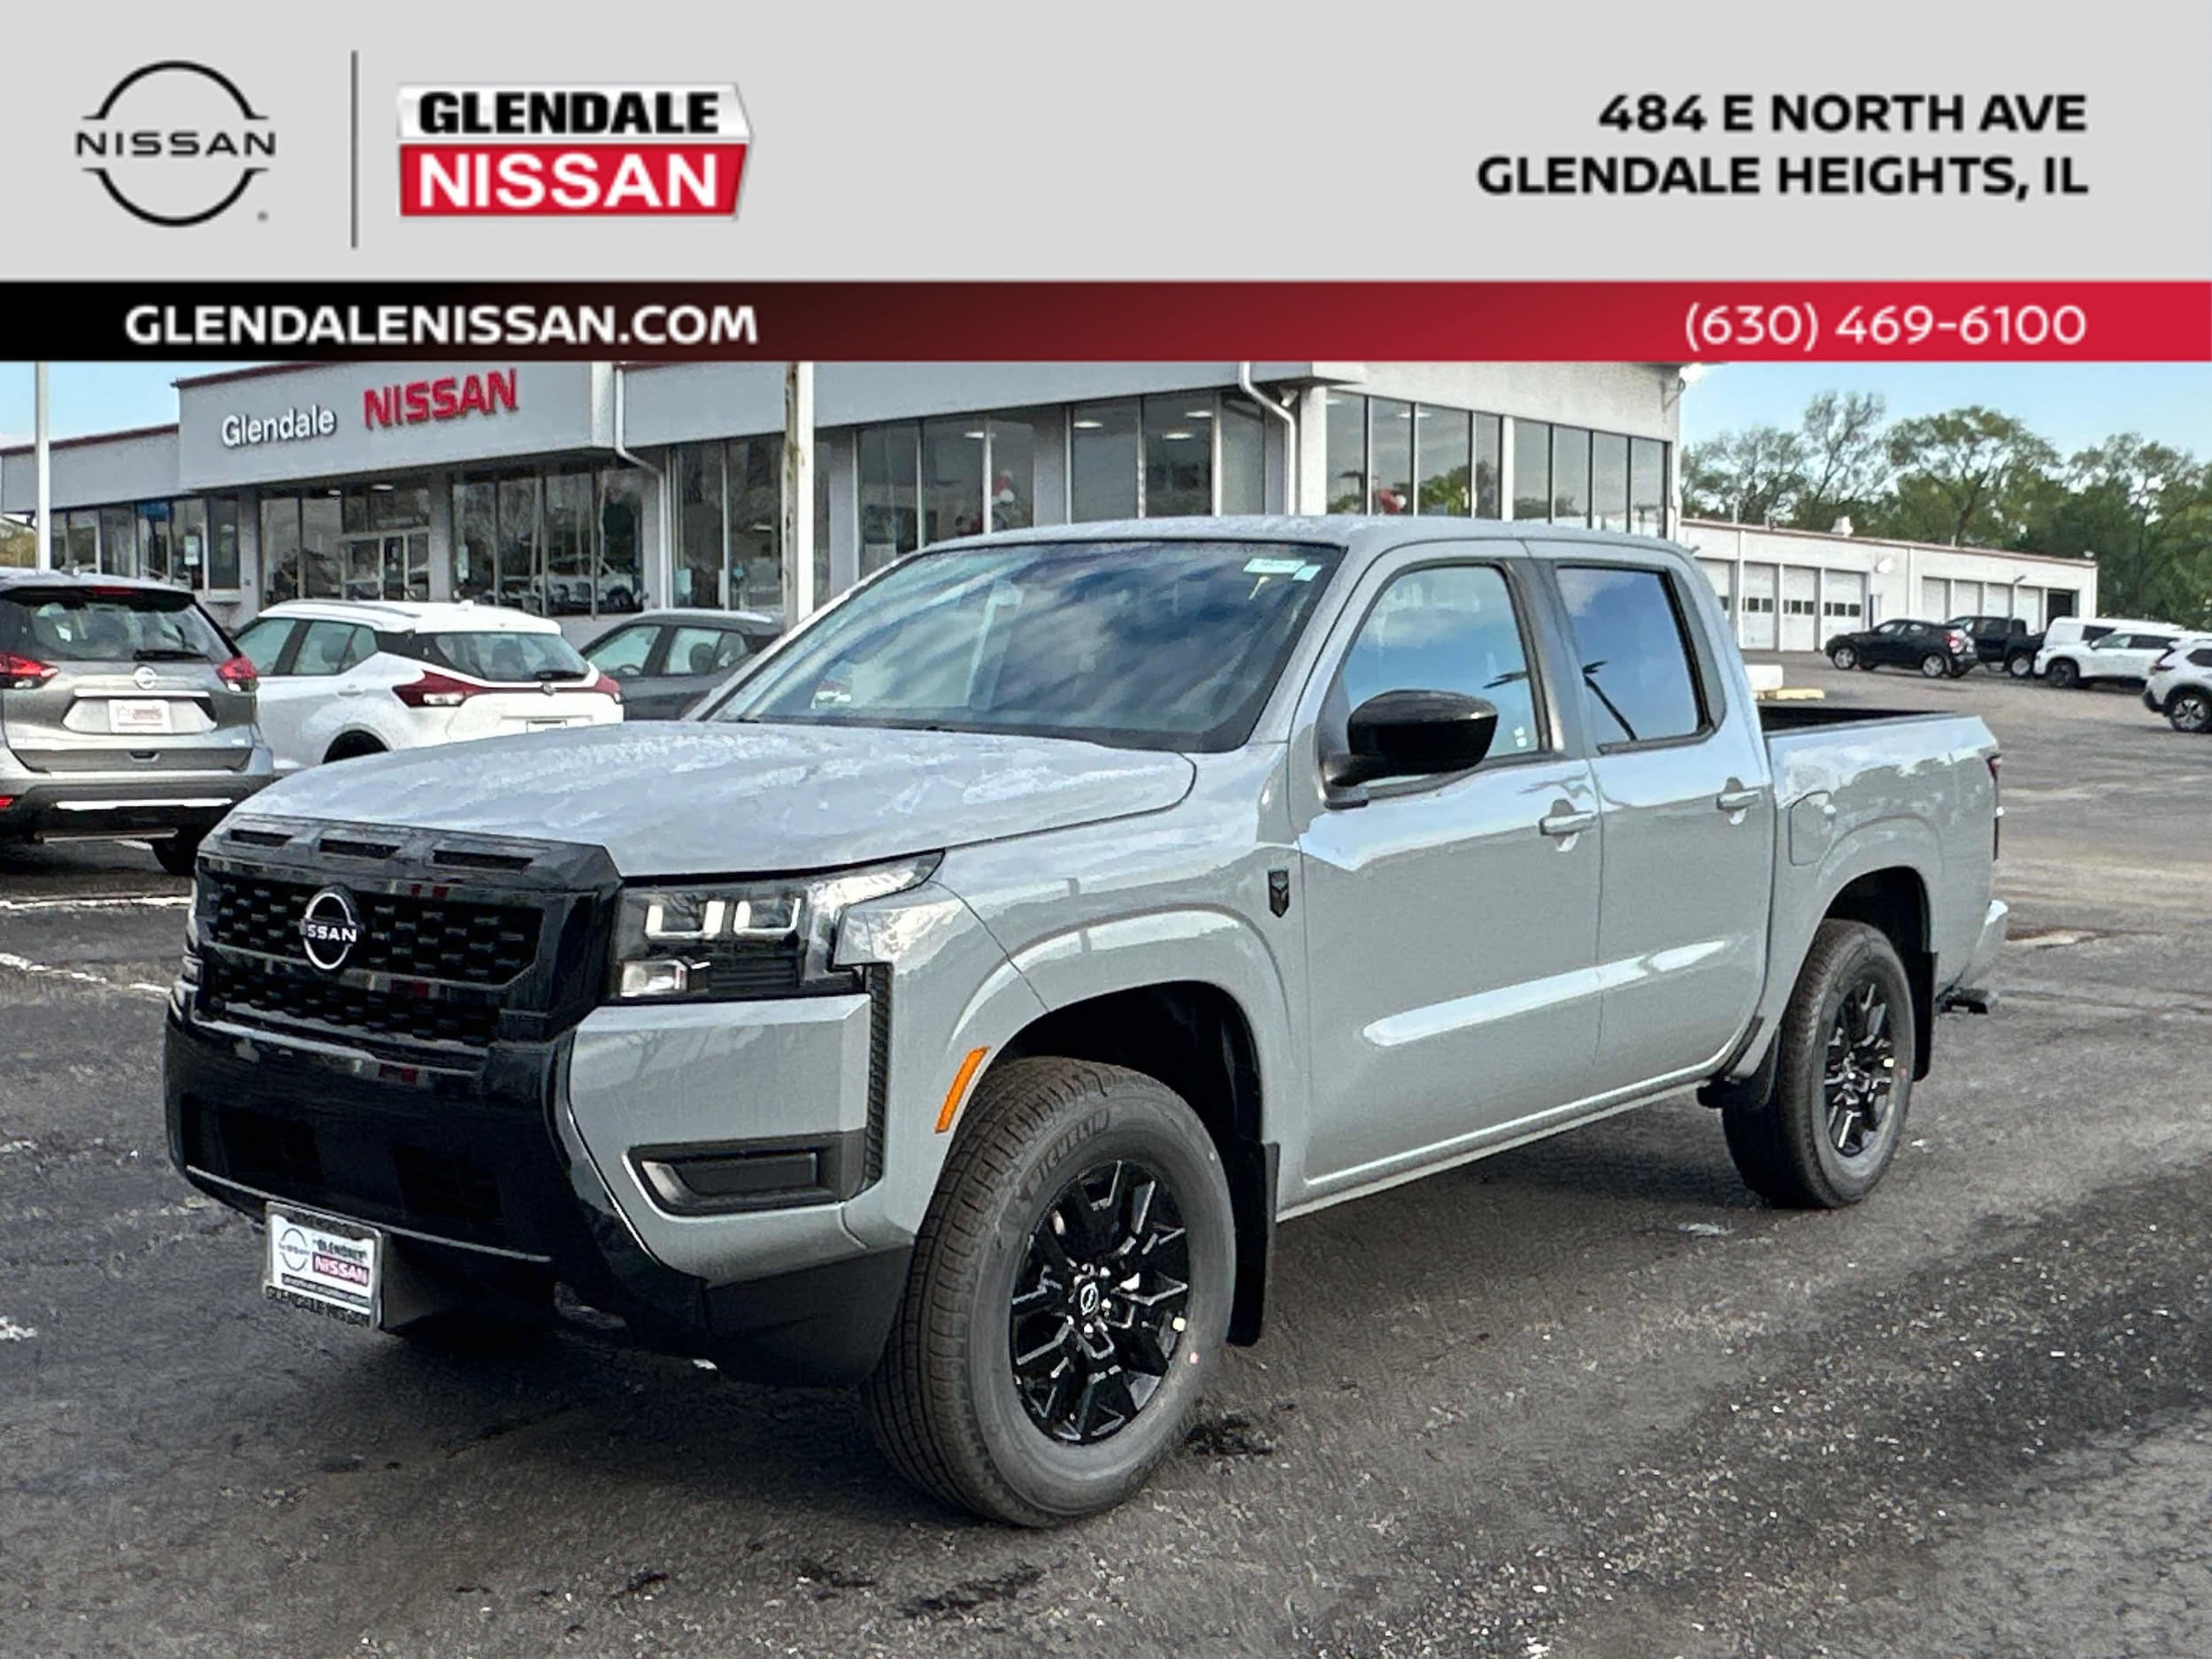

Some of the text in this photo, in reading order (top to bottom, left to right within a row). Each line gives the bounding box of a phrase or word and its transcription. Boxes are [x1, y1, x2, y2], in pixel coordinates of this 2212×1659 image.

[221, 367, 518, 447] Glendale NISSAN
[314, 1255, 367, 1285] NISSAN
